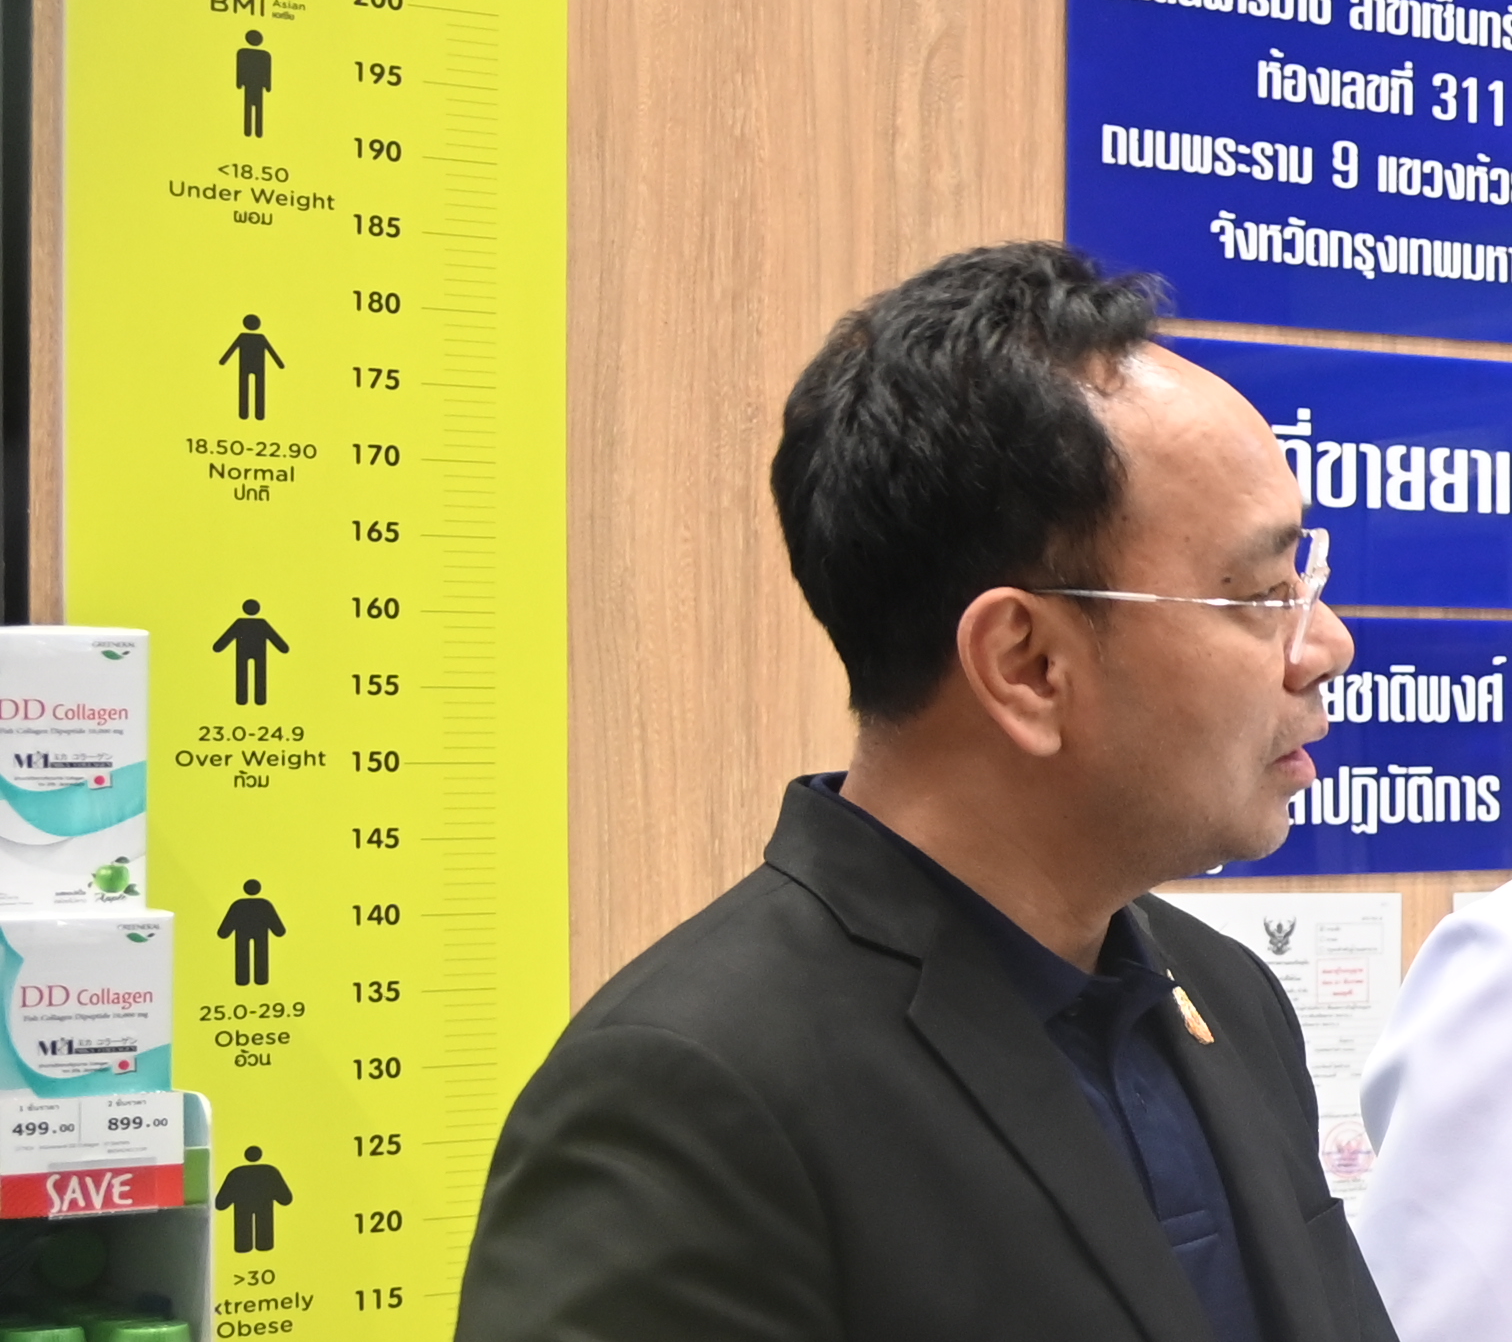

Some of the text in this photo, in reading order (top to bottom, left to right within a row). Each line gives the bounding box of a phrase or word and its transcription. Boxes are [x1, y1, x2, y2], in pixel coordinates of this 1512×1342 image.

[1257, 46, 1415, 118] ห้องเลขที่
[1431, 72, 1505, 128] 311
[354, 137, 403, 162] 190
[1101, 123, 1314, 186] ถนนพระราม
[1331, 140, 1360, 190] 9
[218, 163, 290, 184] <18.50
[169, 180, 336, 213] Under Weight
[233, 210, 273, 227] ผอม
[353, 290, 402, 314] 180
[186, 438, 318, 461] 18.50-22.90
[352, 443, 401, 467] 170
[209, 462, 296, 483] Normal
[234, 484, 271, 502] ปกติ
[352, 597, 401, 620] 160
[52, 703, 129, 726] Collagen
[198, 725, 306, 743] 23.0-24.9
[174, 749, 327, 770] Over Weight
[352, 750, 401, 773] 150
[233, 769, 271, 789] ท้วม
[352, 903, 401, 926] 140
[19, 984, 154, 1010] DD Collagen
[198, 1001, 306, 1022] 25.0-29.9
[213, 1030, 292, 1048] Obese
[234, 1046, 272, 1068] อ้วน
[353, 1057, 402, 1080] 130
[11, 1121, 75, 1137] 499.00
[107, 1116, 169, 1131] 899.00
[45, 1171, 134, 1215] SAVE
[354, 1210, 404, 1234] 120
[216, 1319, 294, 1340] Obese
